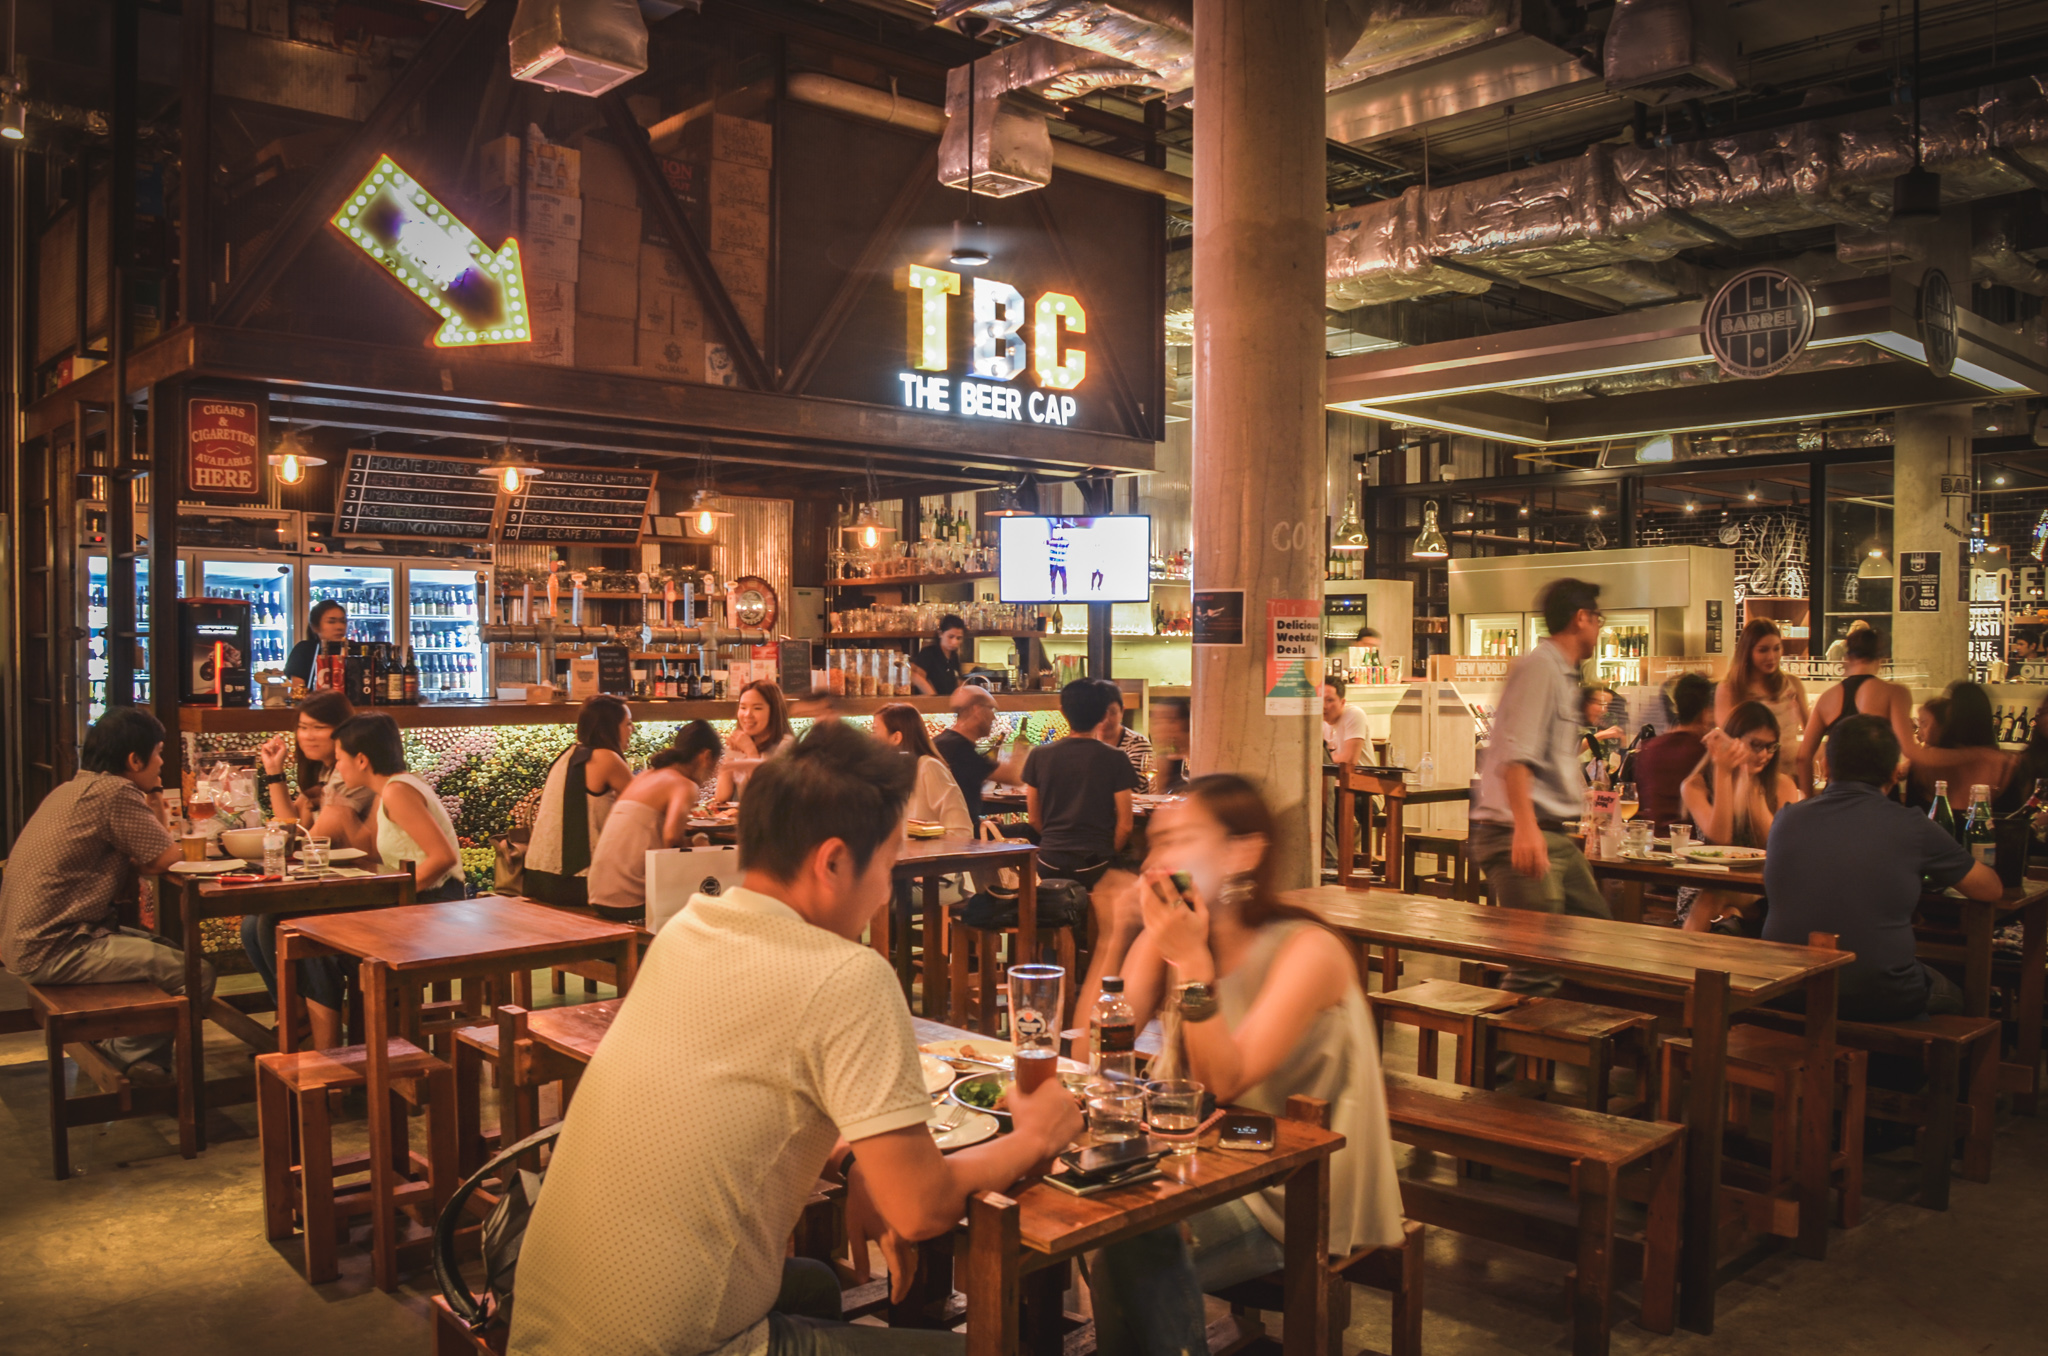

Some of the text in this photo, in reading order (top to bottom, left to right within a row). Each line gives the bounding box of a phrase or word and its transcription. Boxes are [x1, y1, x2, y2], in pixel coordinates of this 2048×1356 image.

[662, 160, 693, 179] ION
[1752, 296, 1764, 306] THE
[903, 264, 1087, 390] TBC
[1721, 309, 1797, 334] BARREL
[1727, 356, 1793, 377] WINE MERCHANT
[899, 373, 1077, 426] THE BEER CAP
[203, 404, 245, 418] CIGARS
[218, 416, 229, 427] &
[191, 428, 256, 447] CIGARETTES
[195, 453, 253, 467] AVAILABLE
[356, 458, 362, 467] 1
[371, 457, 422, 472] HOLGATE
[426, 461, 471, 476] PILSNER
[195, 467, 253, 488] HERE
[352, 473, 360, 482] 2
[368, 474, 413, 488] HERETIC
[415, 478, 450, 489] PORTER
[349, 489, 357, 498] 3
[346, 505, 353, 513] 4
[360, 503, 380, 516] ACE
[380, 505, 432, 518] PINEAPPLE
[434, 508, 468, 520] CIDER
[513, 499, 520, 507] 8
[550, 500, 581, 512] BLACK
[510, 514, 518, 522] 9
[523, 513, 551, 524] FRESH
[343, 521, 350, 530] 5
[381, 522, 405, 533] MID
[407, 522, 463, 535] MOUNTAIN
[505, 528, 517, 537] 10
[521, 528, 544, 538] EPIC
[546, 528, 582, 539] ESCAPE
[585, 529, 601, 539] IPA
[1919, 598, 1937, 607] 180
[1276, 620, 1319, 630] Delicious
[1276, 633, 1319, 645] Weekday
[1276, 645, 1306, 654] Deals
[1455, 662, 1508, 675] NEW WORLD
[1783, 662, 1846, 676] ARKLING
